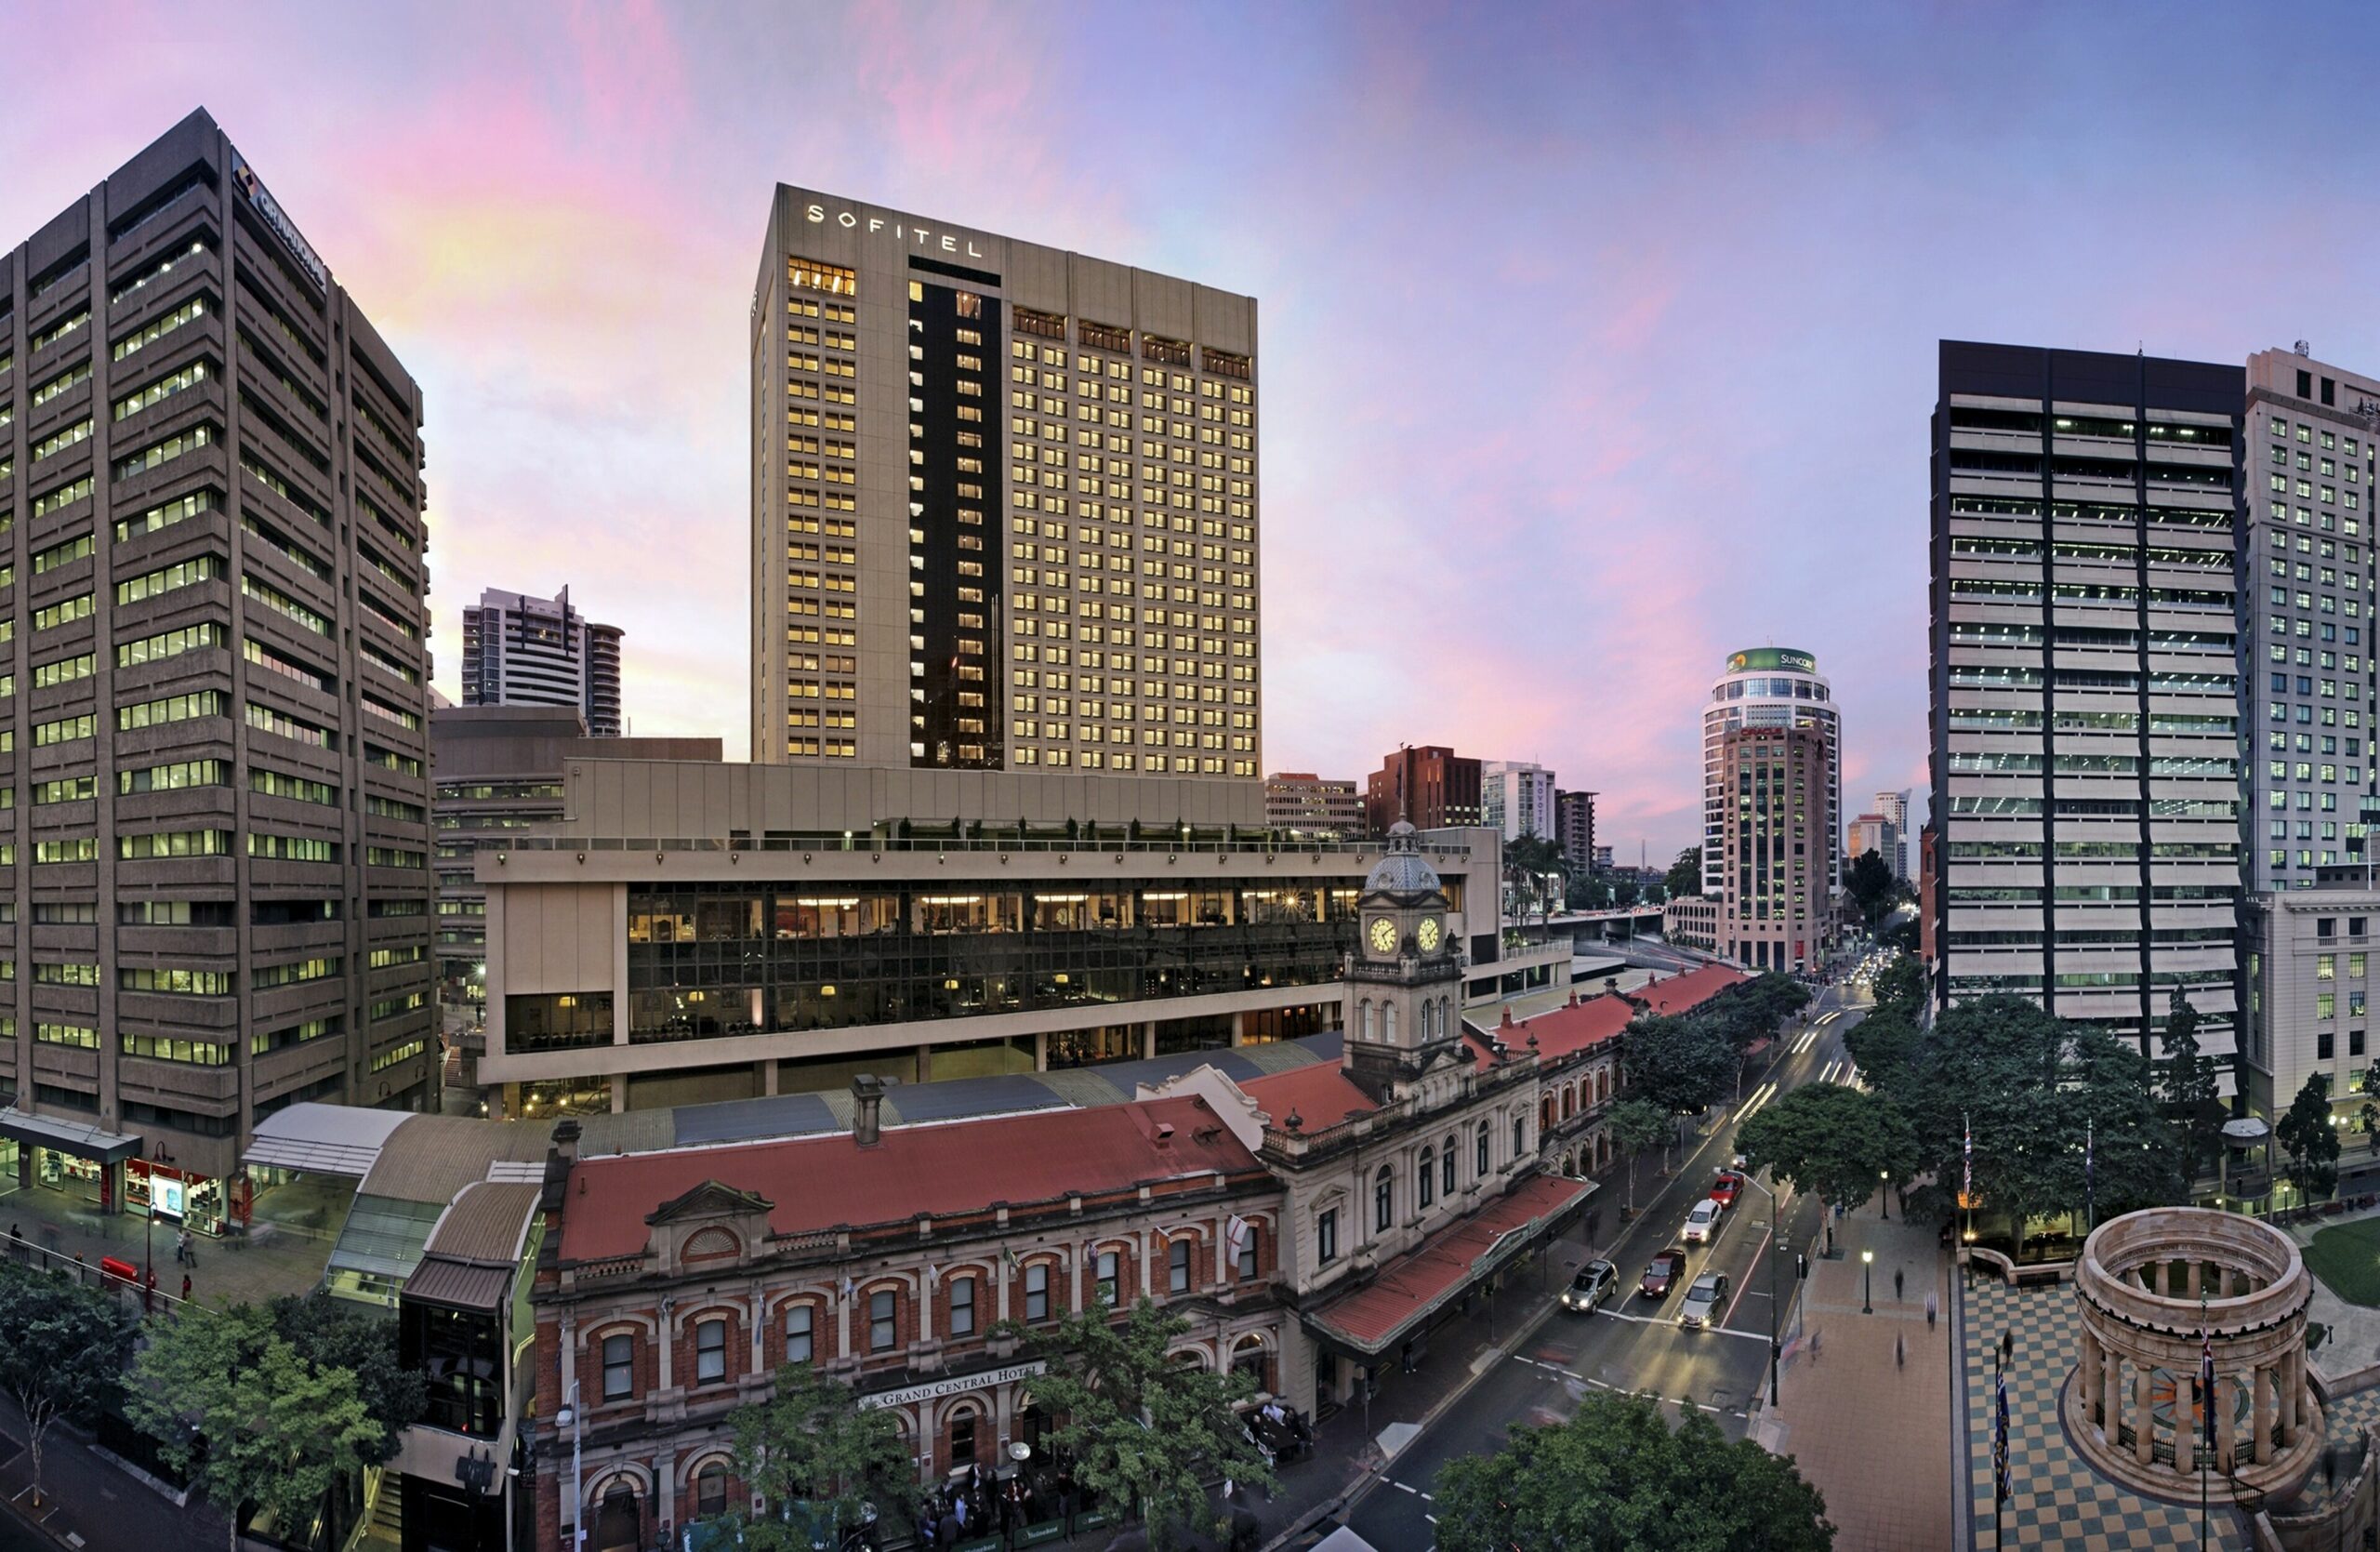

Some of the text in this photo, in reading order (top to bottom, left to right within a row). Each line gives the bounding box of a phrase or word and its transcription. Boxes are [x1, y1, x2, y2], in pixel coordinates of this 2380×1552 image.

[807, 205, 983, 258] SOFITEL
[1740, 727, 1782, 736] ORACLE
[883, 1365, 1038, 1405] GRAND CENTRAL HOTEL
